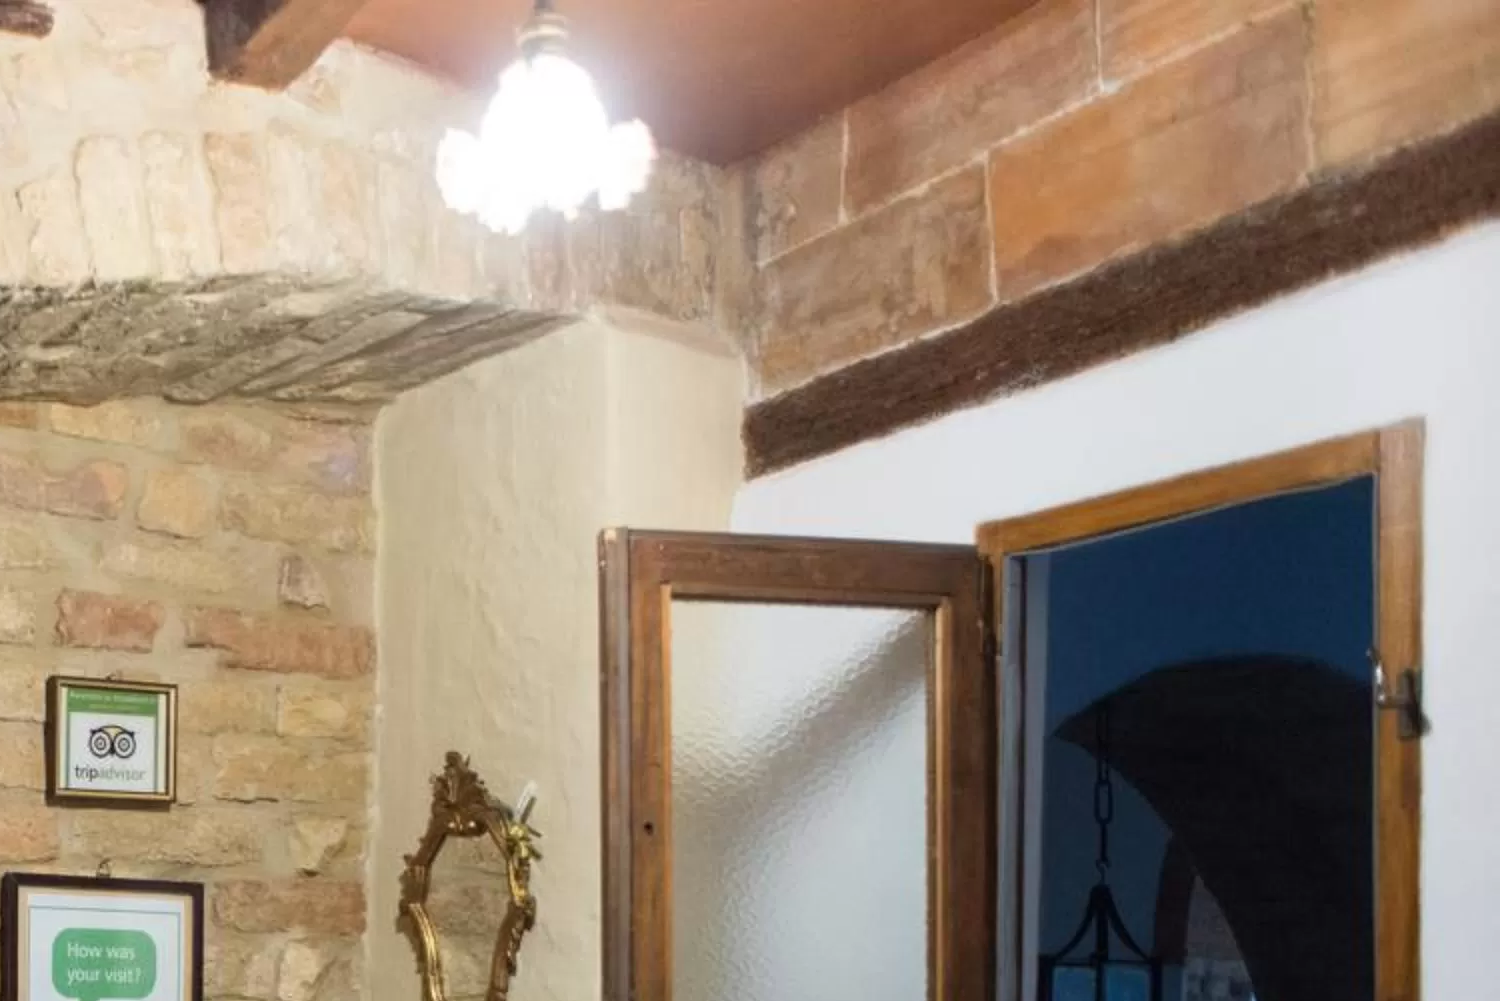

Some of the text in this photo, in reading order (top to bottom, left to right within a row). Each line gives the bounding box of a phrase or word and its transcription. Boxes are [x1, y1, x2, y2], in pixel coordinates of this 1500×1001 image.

[74, 764, 147, 781] tripadvisor
[67, 941, 136, 960] How was
[67, 966, 142, 986] your visit?
